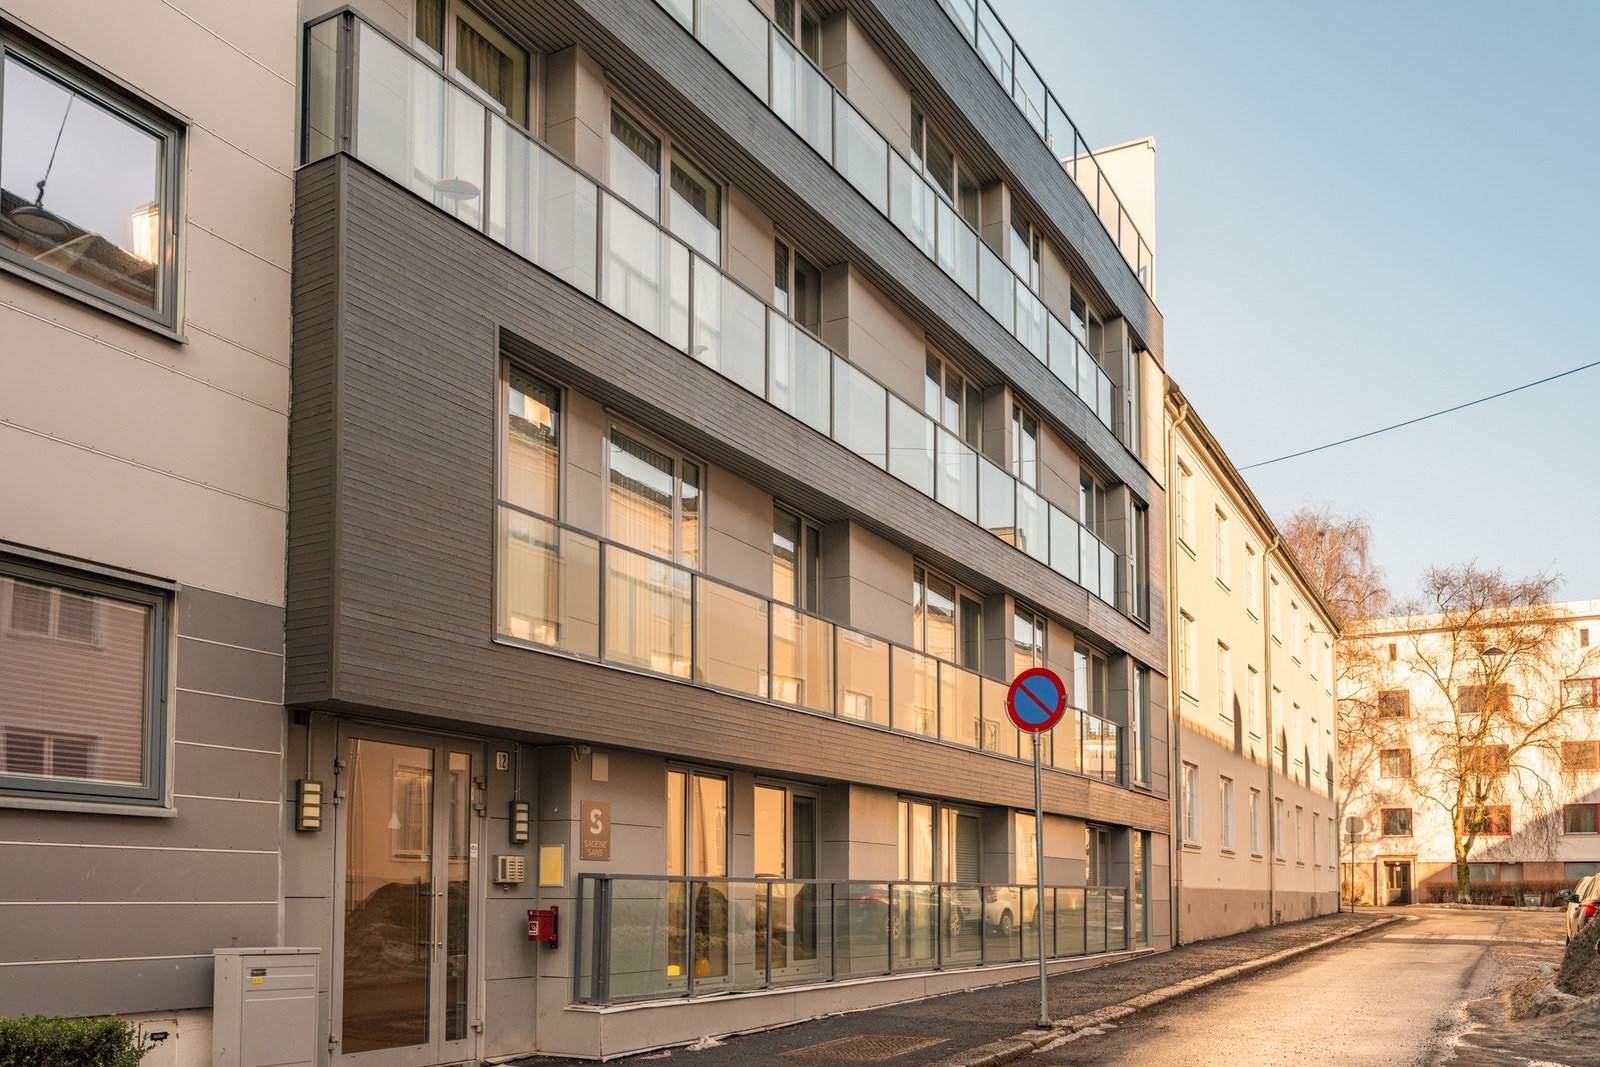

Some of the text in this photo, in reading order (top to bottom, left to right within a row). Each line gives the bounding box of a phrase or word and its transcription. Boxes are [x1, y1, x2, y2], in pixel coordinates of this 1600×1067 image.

[498, 754, 507, 769] 12
[589, 808, 603, 835] S
[583, 839, 608, 849] SAGENE
[587, 848, 604, 857] SANS
